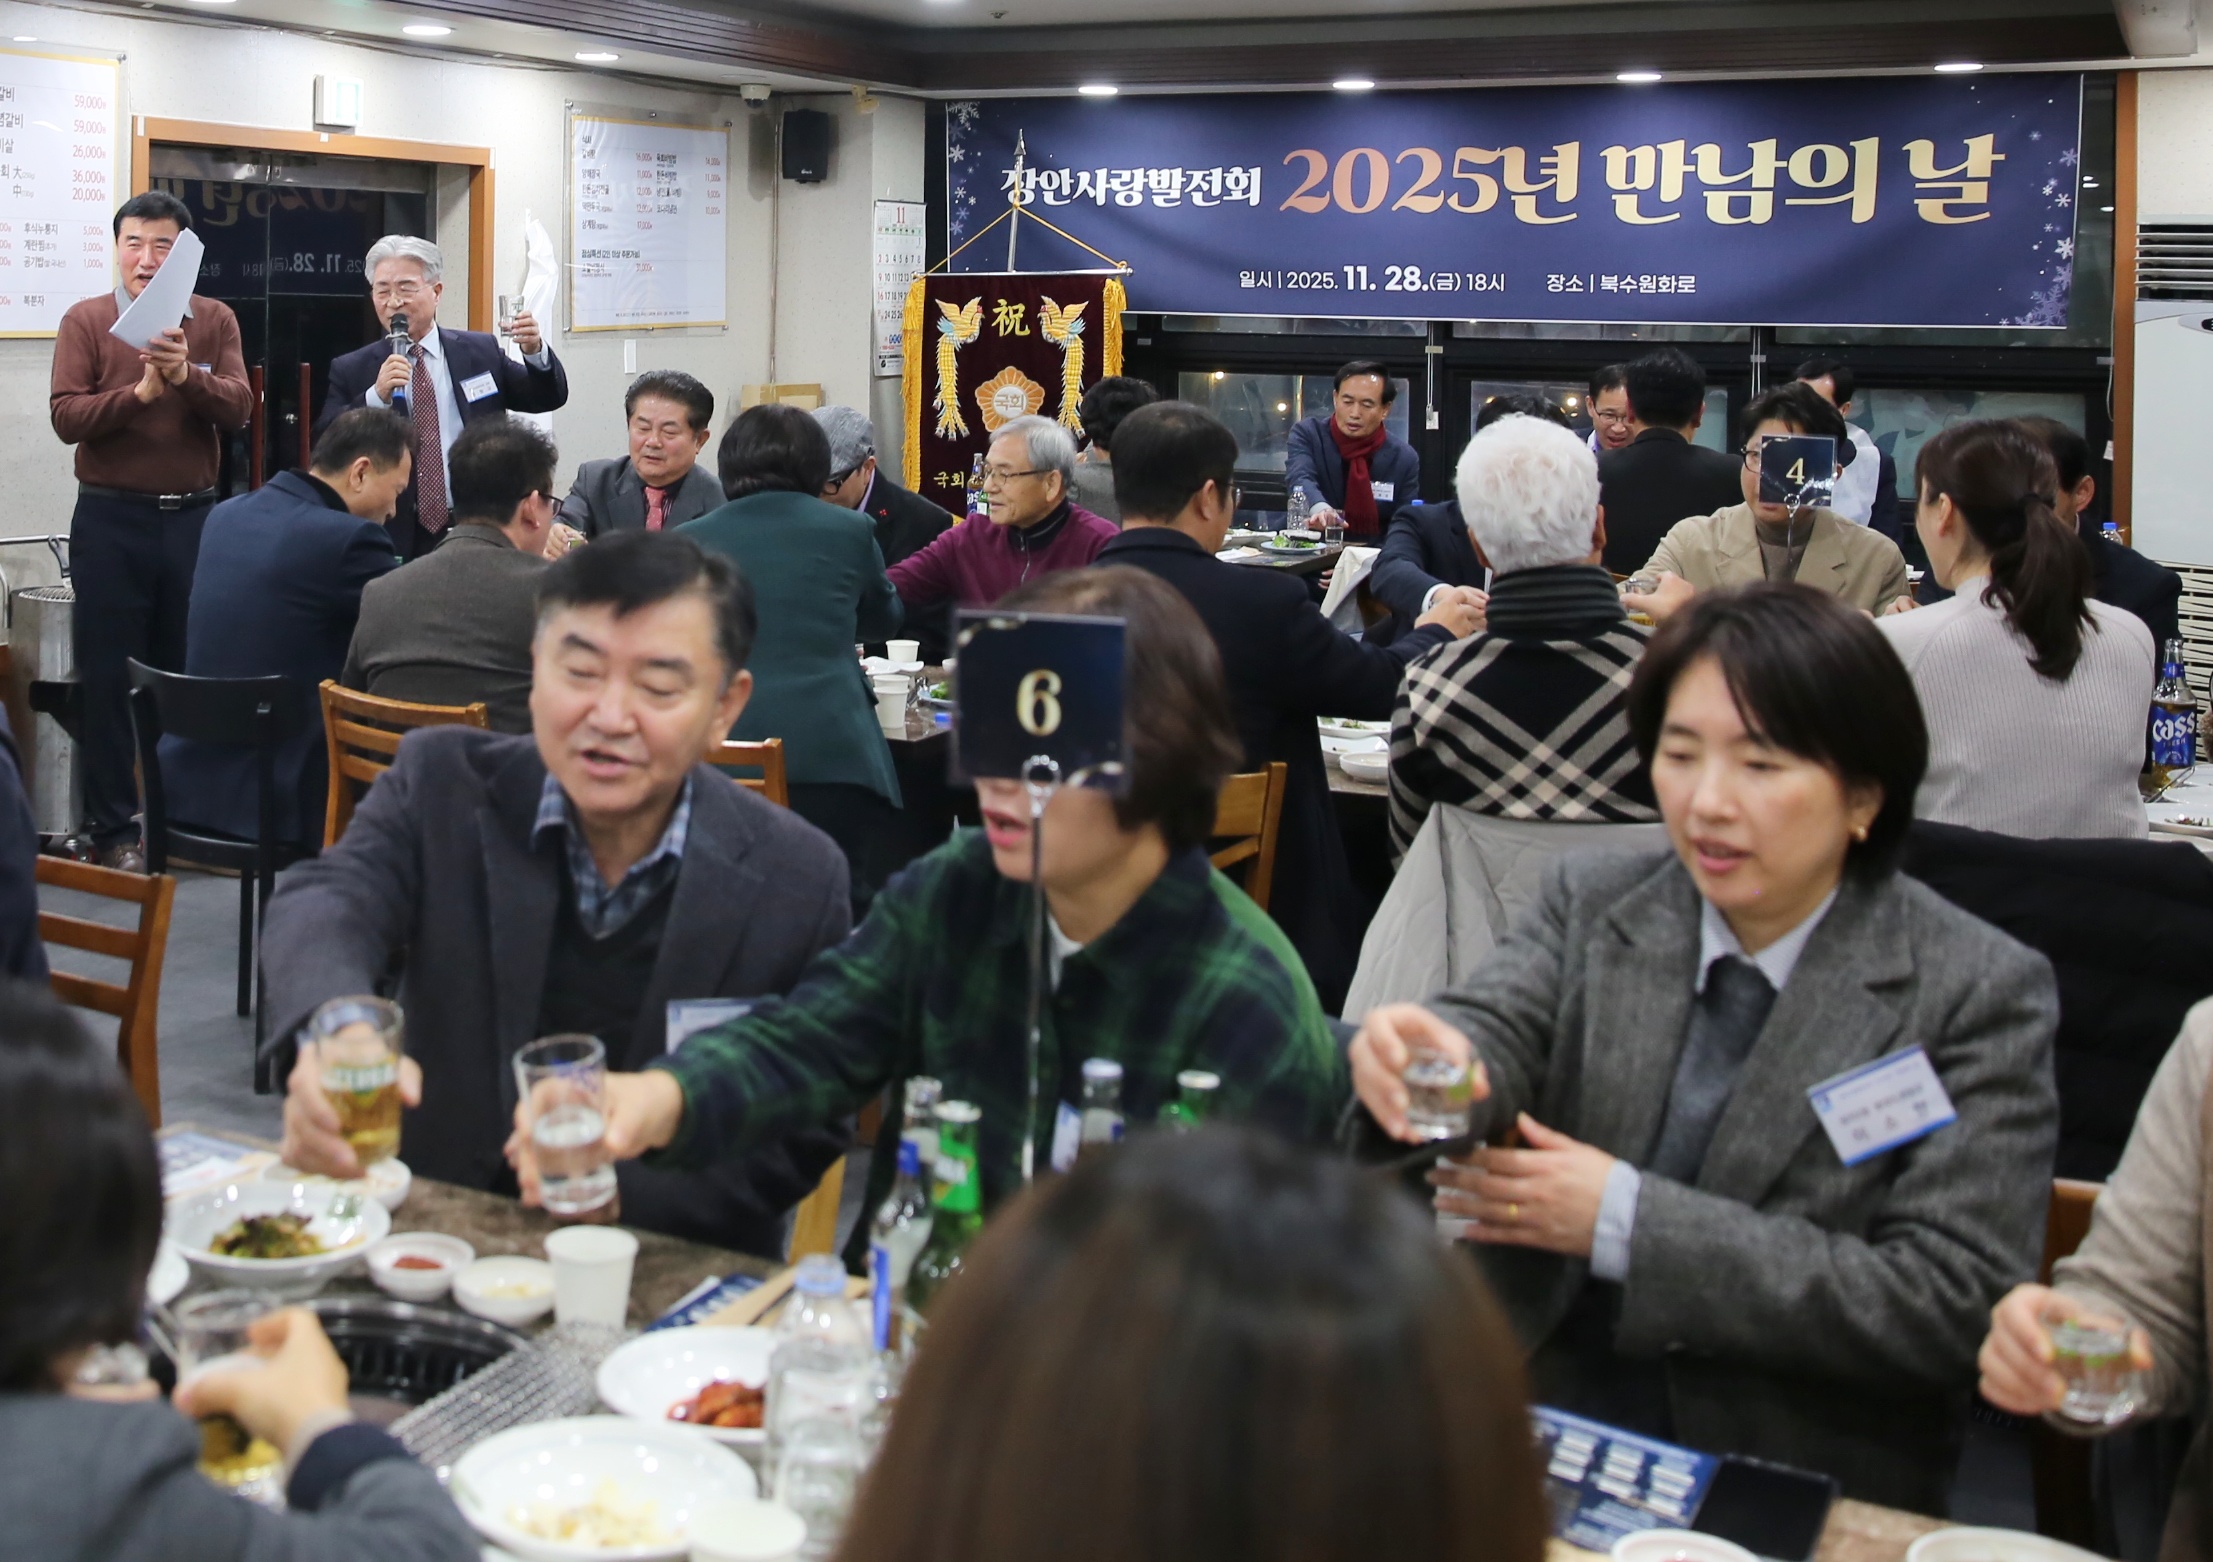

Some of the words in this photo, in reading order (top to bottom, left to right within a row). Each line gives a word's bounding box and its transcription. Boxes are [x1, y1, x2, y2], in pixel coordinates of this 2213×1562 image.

[1000, 167, 1262, 208] 장안사랑발전회
[1280, 141, 1580, 225] 2025년
[1599, 137, 1879, 225] 만남의
[1901, 133, 2006, 225] 날
[896, 206, 905, 224] 11
[1239, 270, 1273, 289] 일시
[1286, 271, 1339, 290] 2025.
[1343, 265, 1377, 292] 11.
[1466, 273, 1506, 293] 18시
[1546, 273, 1585, 293] 장소
[1600, 274, 1697, 294] 북수원화로
[991, 298, 1031, 337] 祝
[995, 394, 1024, 411] 국회
[933, 470, 965, 489] 국회
[1785, 457, 1806, 486] 4
[1016, 668, 1062, 737] 6
